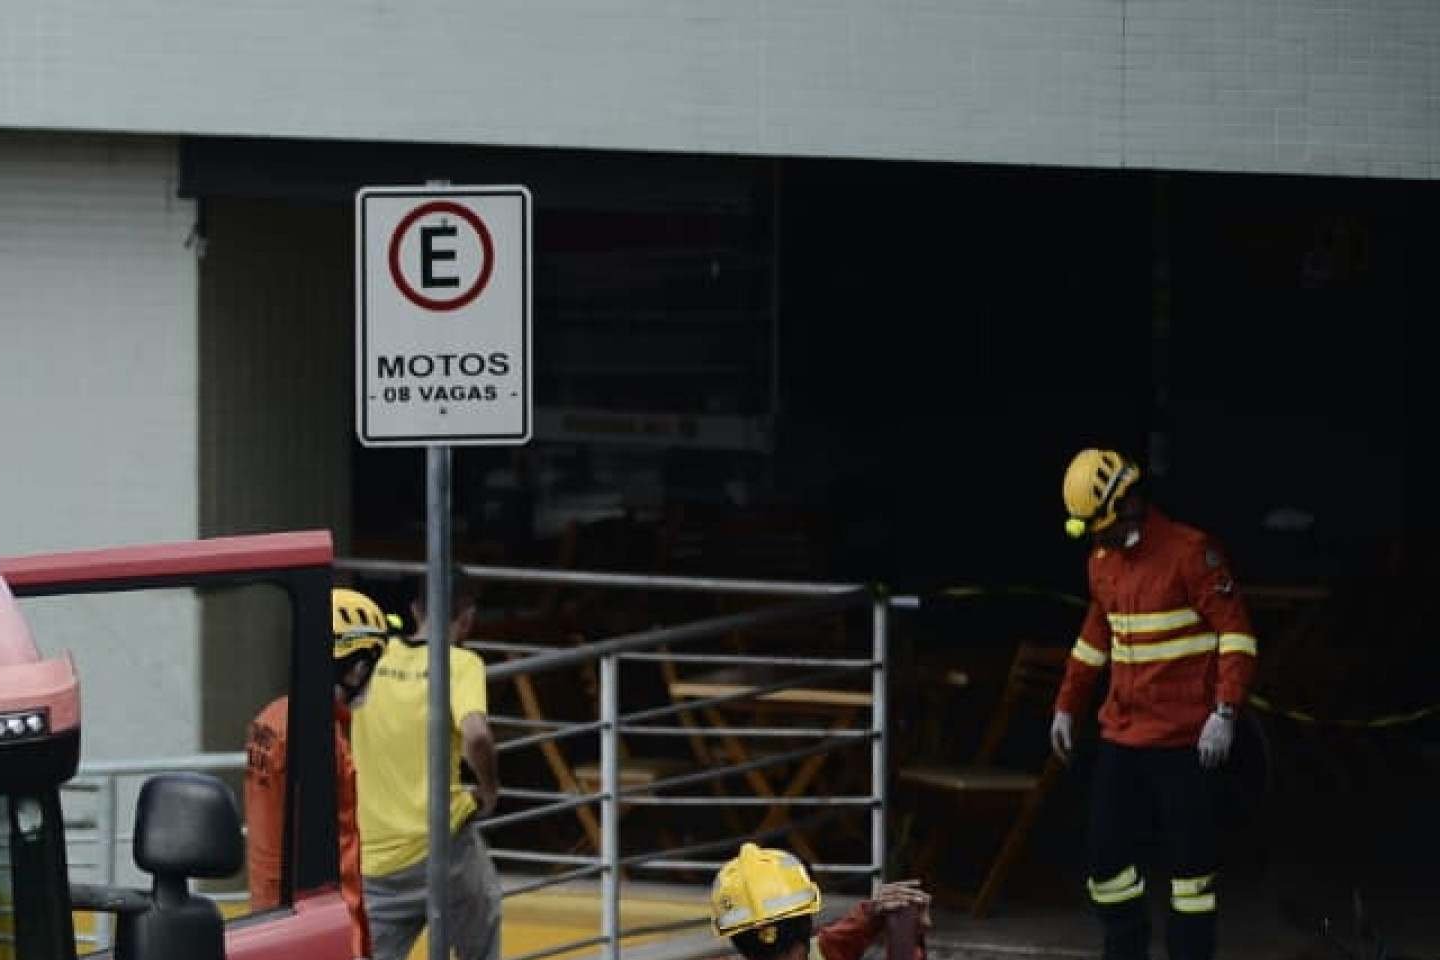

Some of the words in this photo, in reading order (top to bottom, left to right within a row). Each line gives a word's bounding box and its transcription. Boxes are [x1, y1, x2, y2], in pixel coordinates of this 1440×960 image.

[377, 352, 510, 379] MOTOS
[383, 386, 411, 403] 08
[418, 384, 498, 403] VAGAS
